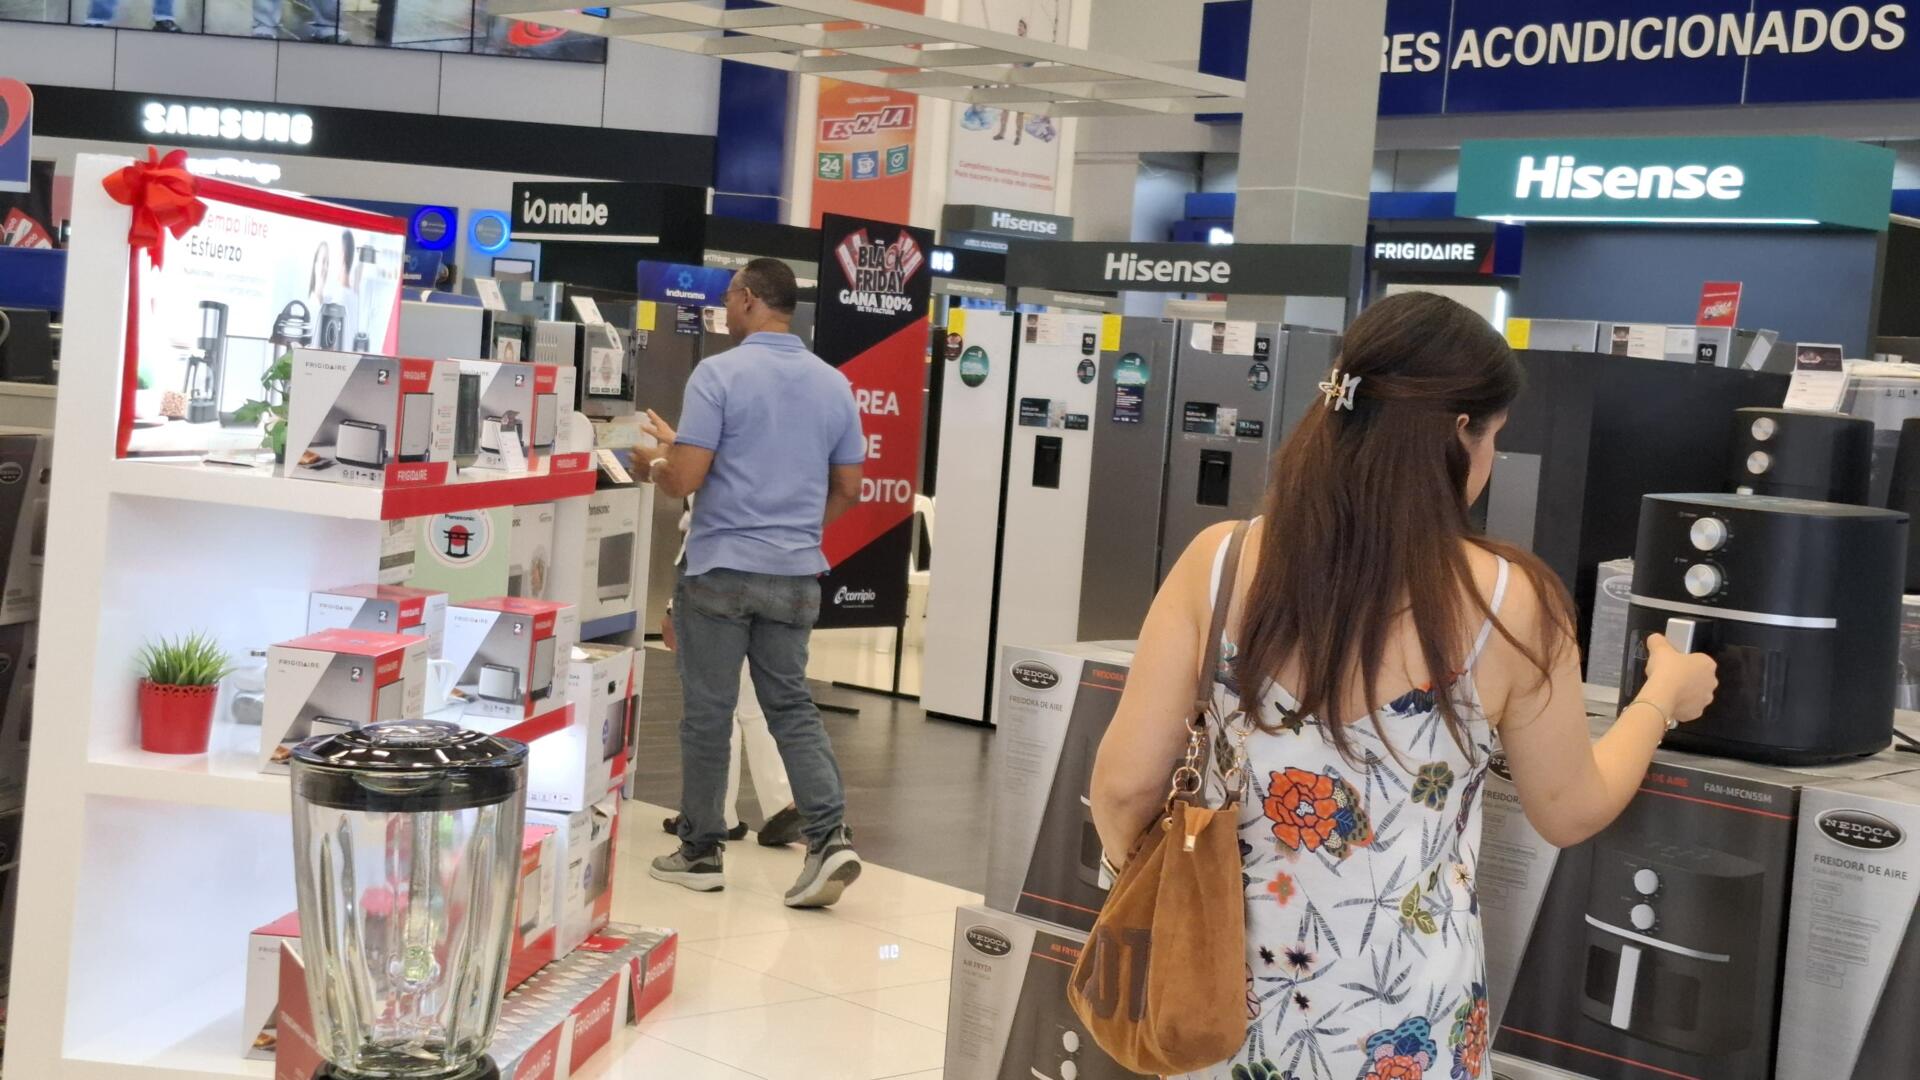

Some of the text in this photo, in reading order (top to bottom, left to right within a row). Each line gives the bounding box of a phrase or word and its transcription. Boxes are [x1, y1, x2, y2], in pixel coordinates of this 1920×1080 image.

[1451, 4, 1906, 70] ACONDICIONADOS
[143, 102, 313, 145] SAMSUNG
[827, 108, 905, 139] ESCALA
[820, 157, 841, 173] 24
[1515, 155, 1744, 201] Hisense
[548, 192, 609, 226] mabe
[207, 213, 269, 239] empo libre
[991, 210, 1058, 236] Hisense
[857, 243, 906, 272] BLACK
[1374, 242, 1476, 261] FRIGIDAIRE
[1104, 252, 1231, 284] Hisense
[854, 268, 906, 295] FRIDAY
[839, 289, 913, 313] GANA 100%
[1700, 346, 1713, 358] 10
[305, 360, 348, 372] FRIGIDAIRE
[856, 387, 900, 417] REA
[397, 469, 429, 481] FRIGIDAIRE
[860, 477, 912, 504] DITO
[444, 513, 475, 522] Panasonic
[278, 658, 320, 669] FRIGIDAIRE
[1015, 667, 1056, 681] NEDOCA
[1039, 701, 1049, 709] DE
[1049, 701, 1064, 712] AIRE
[1666, 775, 1689, 788] AIRE
[1824, 818, 1896, 840] NEDOCA
[1813, 853, 1909, 881] FREIDORA DE AIRE
[969, 932, 1009, 949] NEDOCA
[574, 996, 612, 1040] FRIGIDAIRE
